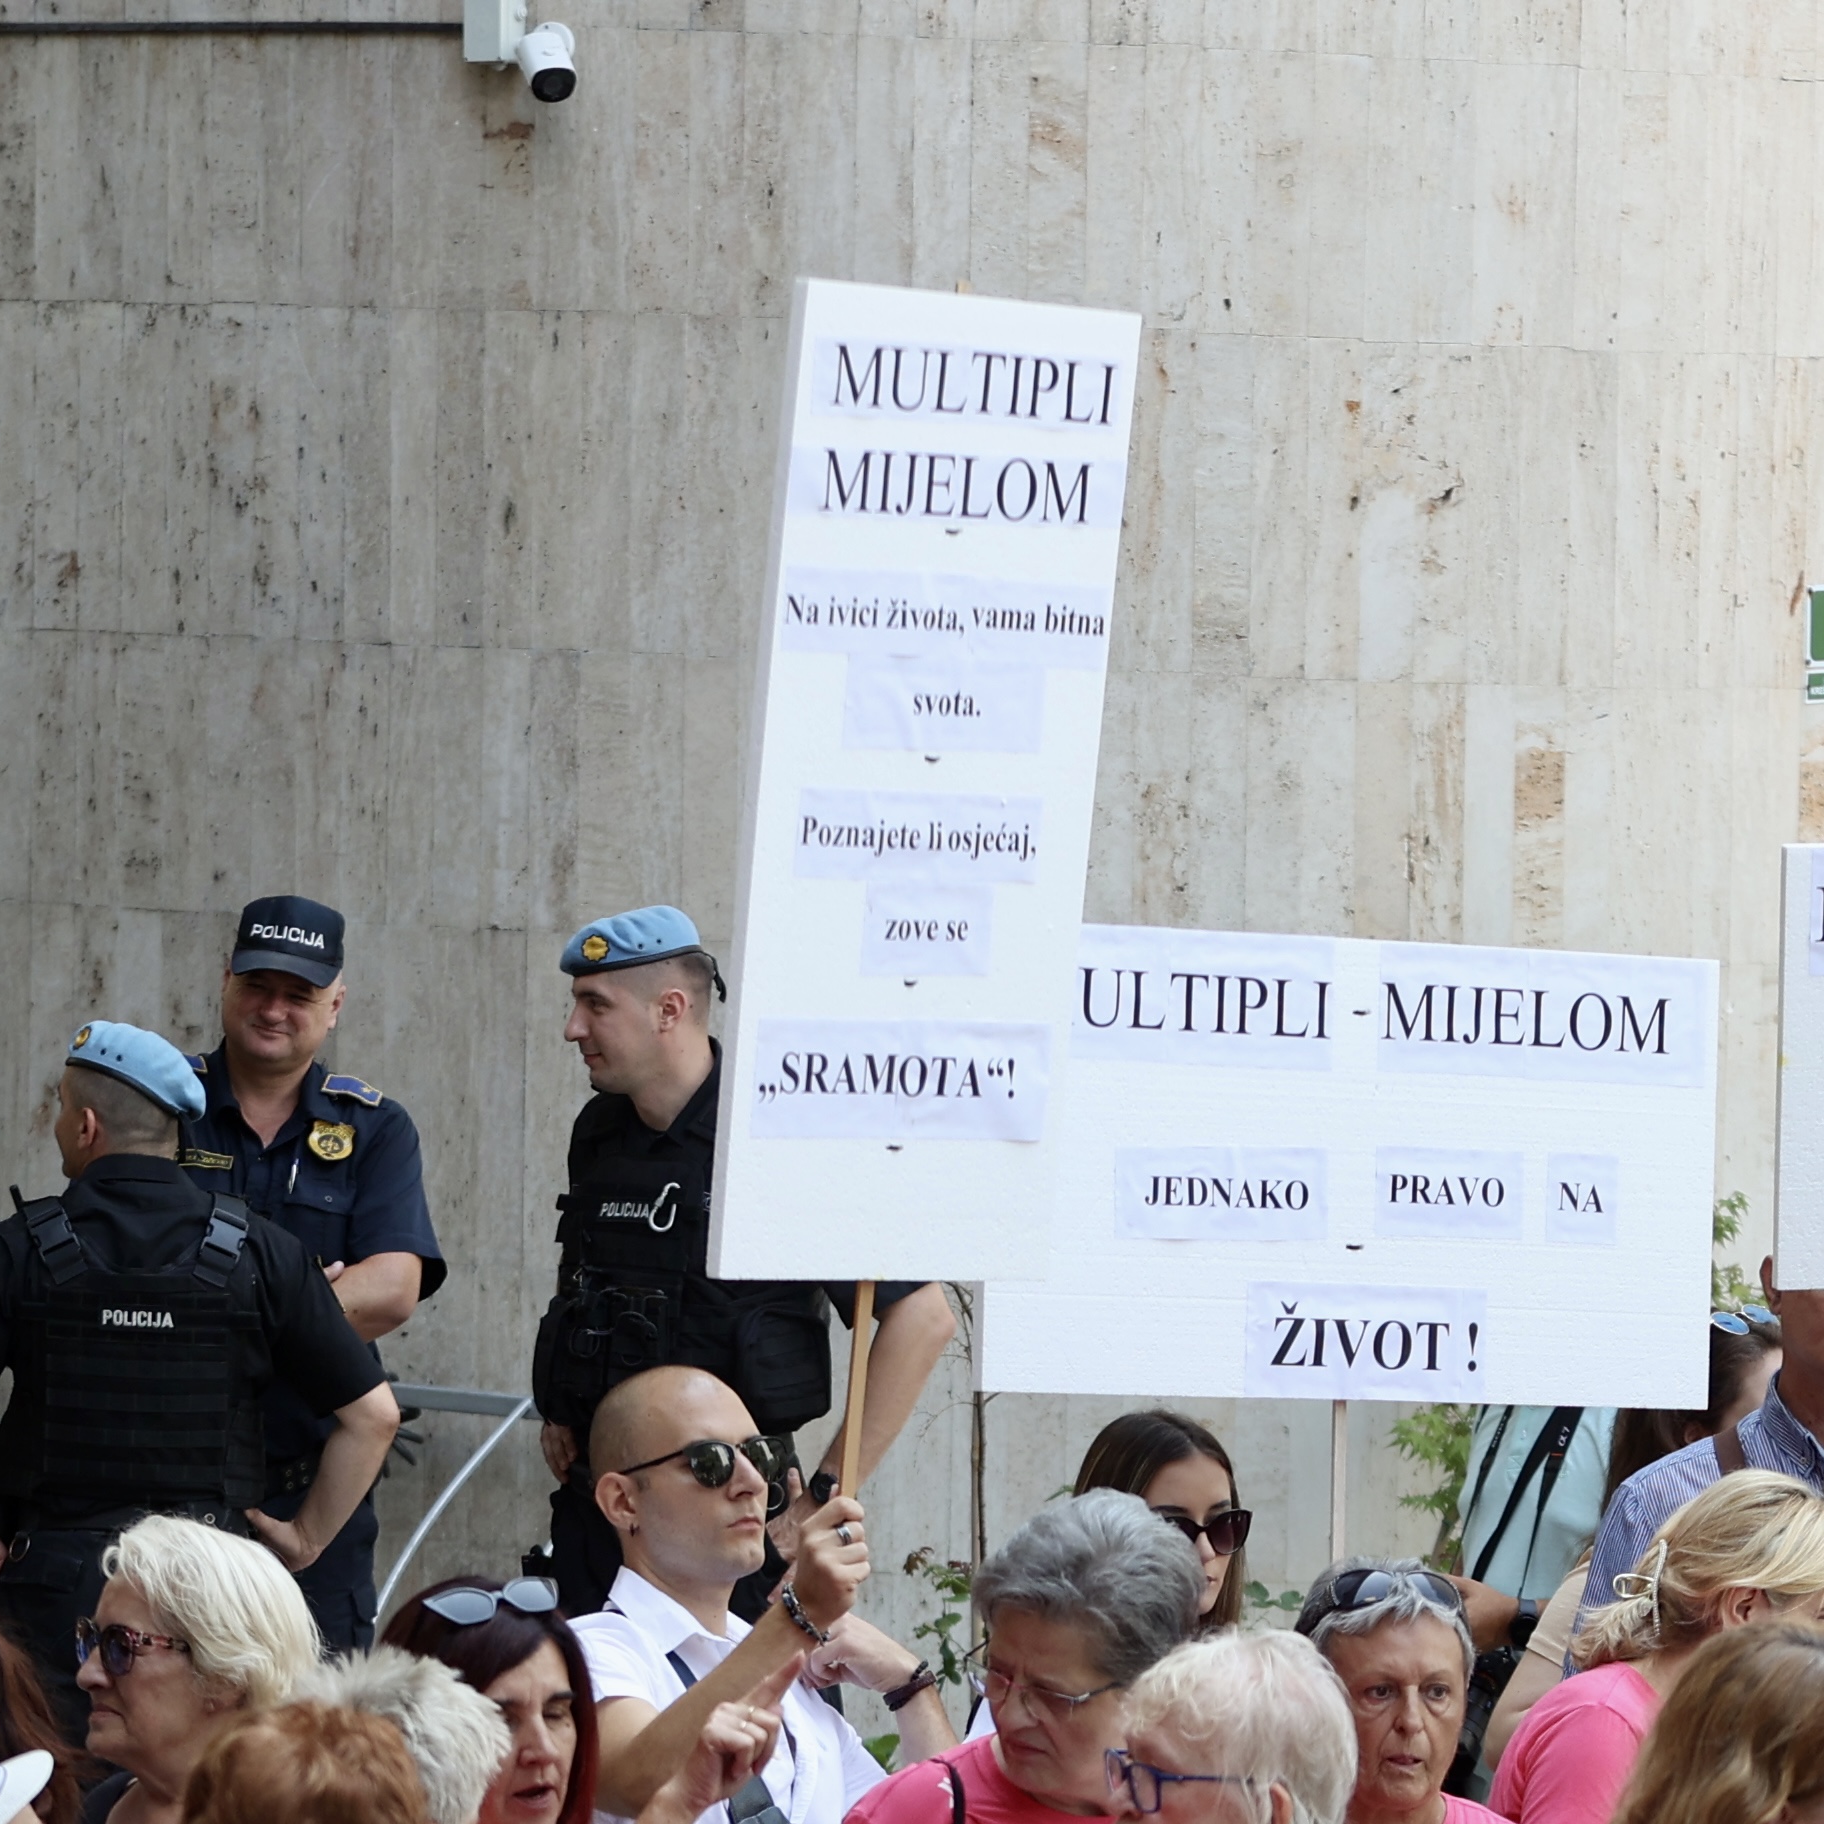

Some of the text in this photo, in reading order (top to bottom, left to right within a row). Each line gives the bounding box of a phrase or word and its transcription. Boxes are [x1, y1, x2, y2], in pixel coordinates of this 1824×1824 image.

[833, 343, 1115, 426] MULTIPLI
[822, 448, 1091, 525] MIJELOM
[785, 594, 1106, 637] Na ivici života, vama bitna
[913, 690, 982, 718] svota.
[801, 815, 1038, 862] Poznajete li osjećaj,
[249, 923, 326, 950] POLICIJA
[884, 918, 970, 943] zove se
[1078, 966, 1670, 1056] ULTIPLI MIJELOM
[599, 1202, 650, 1218] POLICIJA
[1142, 1172, 1605, 1215] JEDNAKO PRAVO NA
[101, 1309, 174, 1328] POLICIJA
[1268, 1300, 1480, 1374] ŽIVOT !
